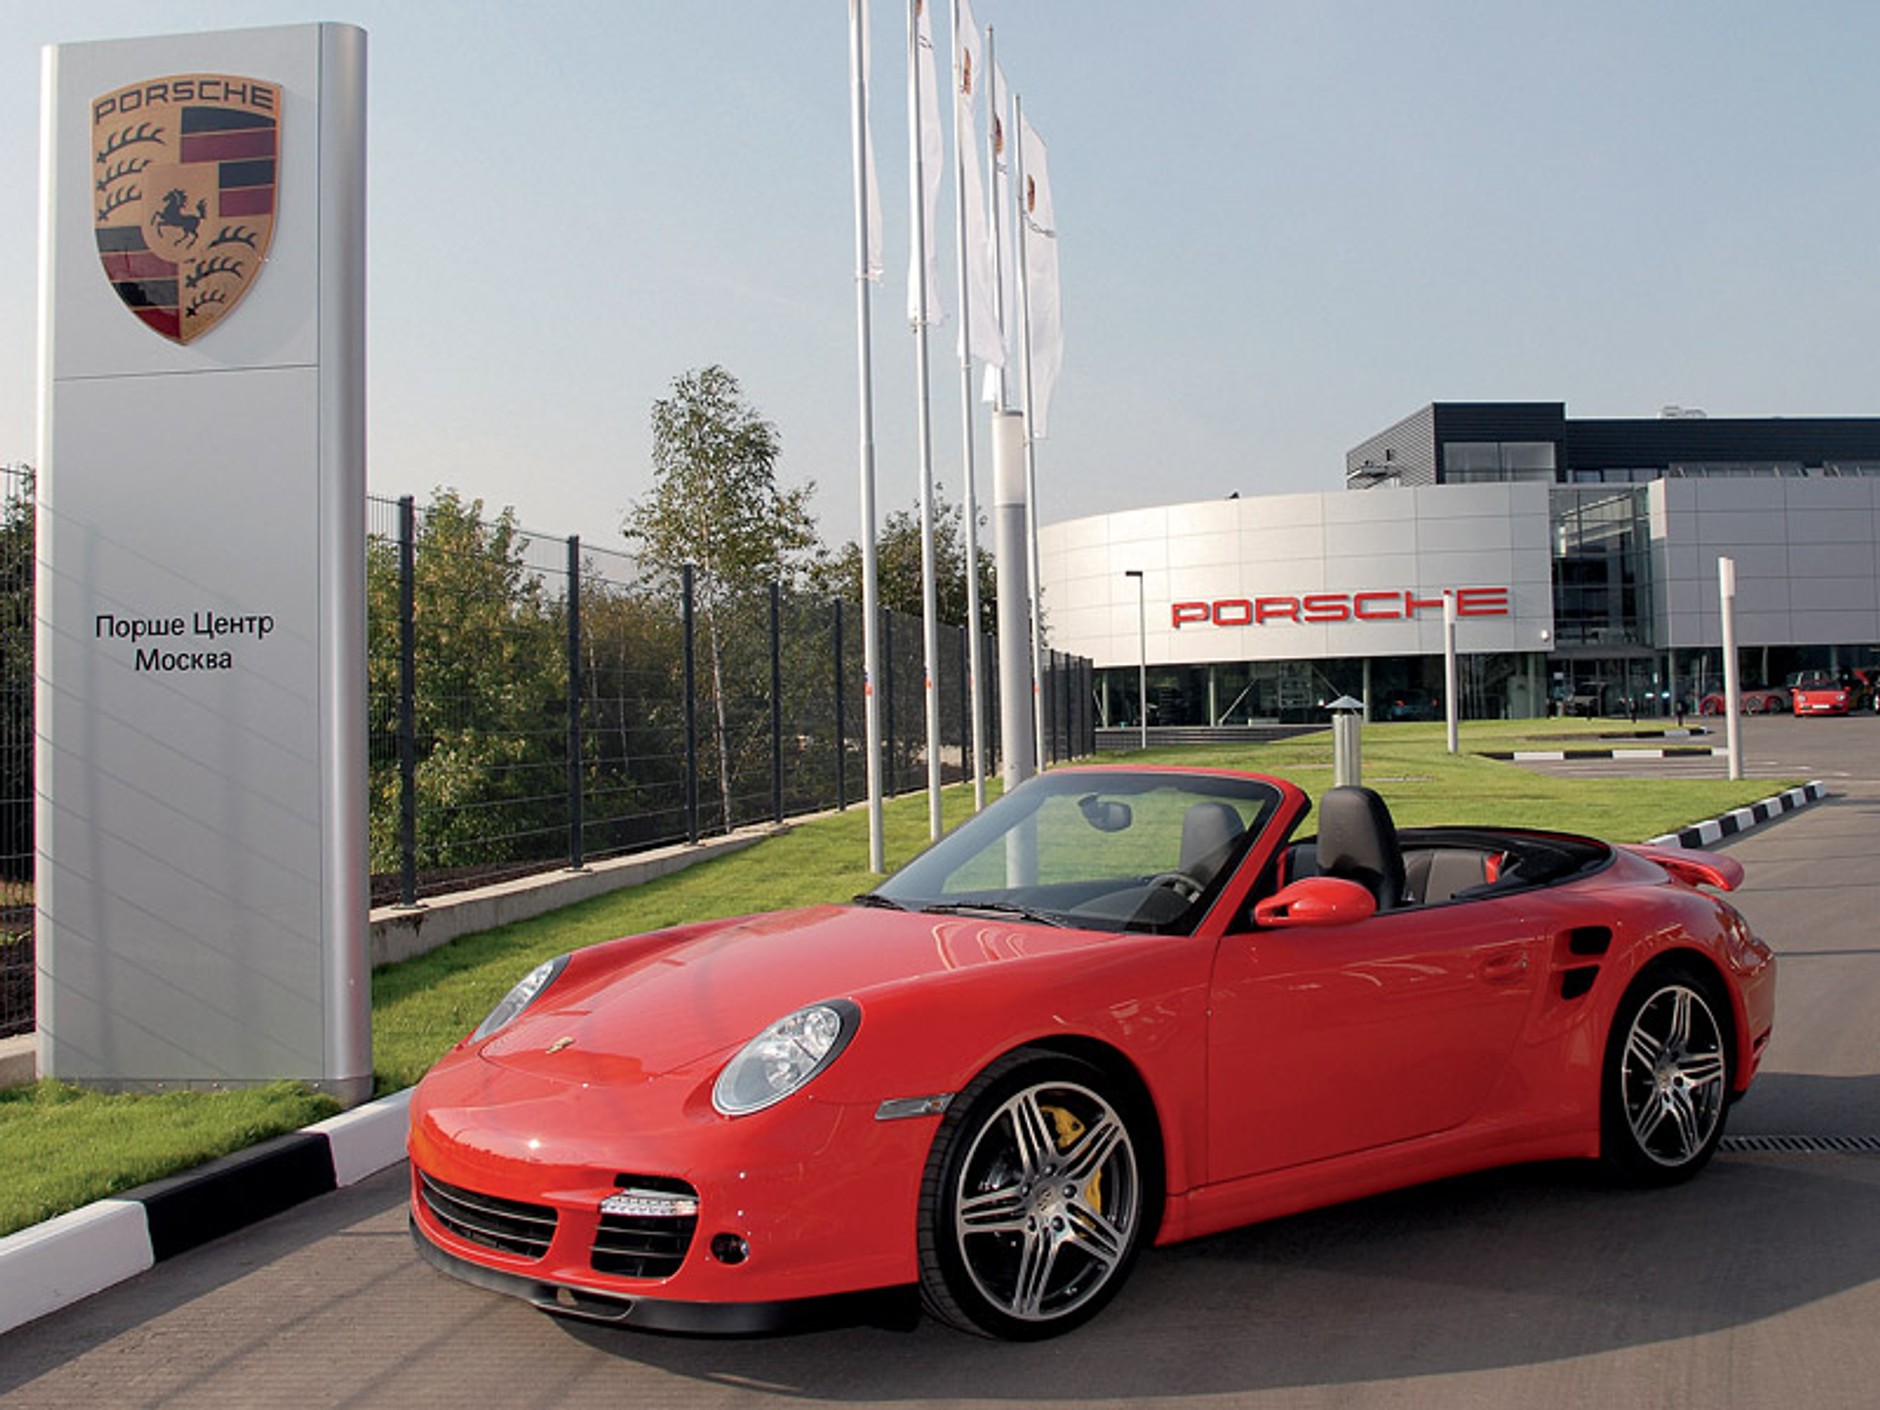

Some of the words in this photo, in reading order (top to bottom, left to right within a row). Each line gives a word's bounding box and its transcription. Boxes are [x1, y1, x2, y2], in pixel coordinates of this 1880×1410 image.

[95, 80, 273, 125] PORSCHE
[1171, 587, 1508, 629] PORSCHE
[96, 614, 185, 643] Порше
[193, 611, 274, 640] Центр
[134, 648, 232, 671] Москва
